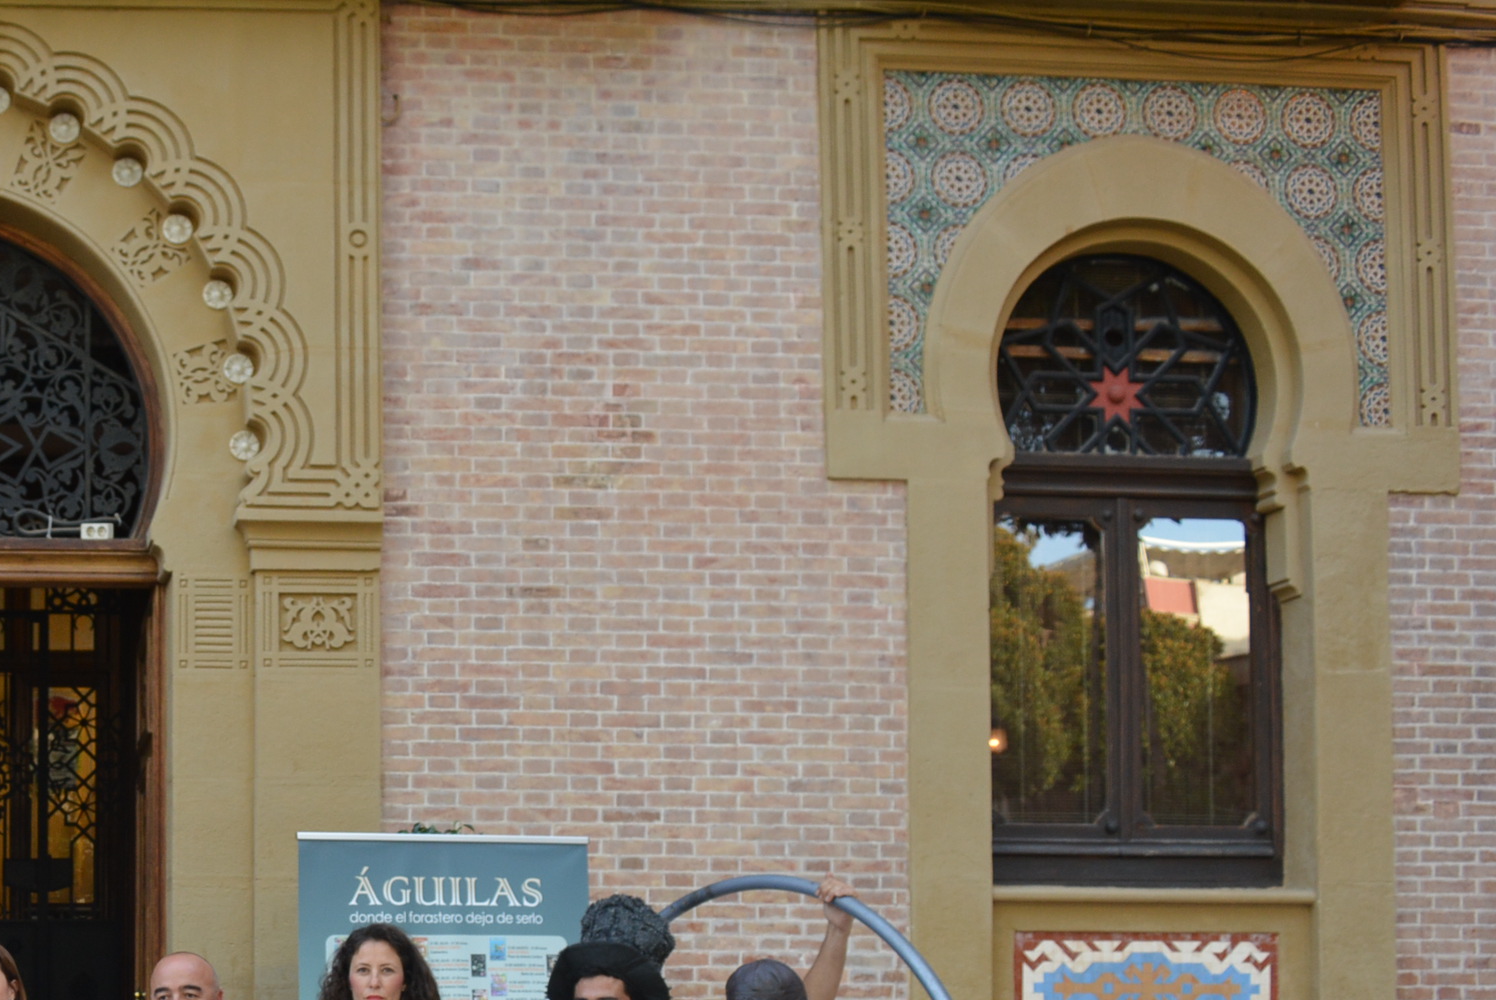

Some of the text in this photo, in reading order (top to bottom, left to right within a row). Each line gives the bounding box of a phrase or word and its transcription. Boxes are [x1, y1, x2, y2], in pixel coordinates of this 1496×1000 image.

[349, 867, 543, 907] ÁGUILAS
[349, 911, 543, 926] donde el forastero deja de serlo
